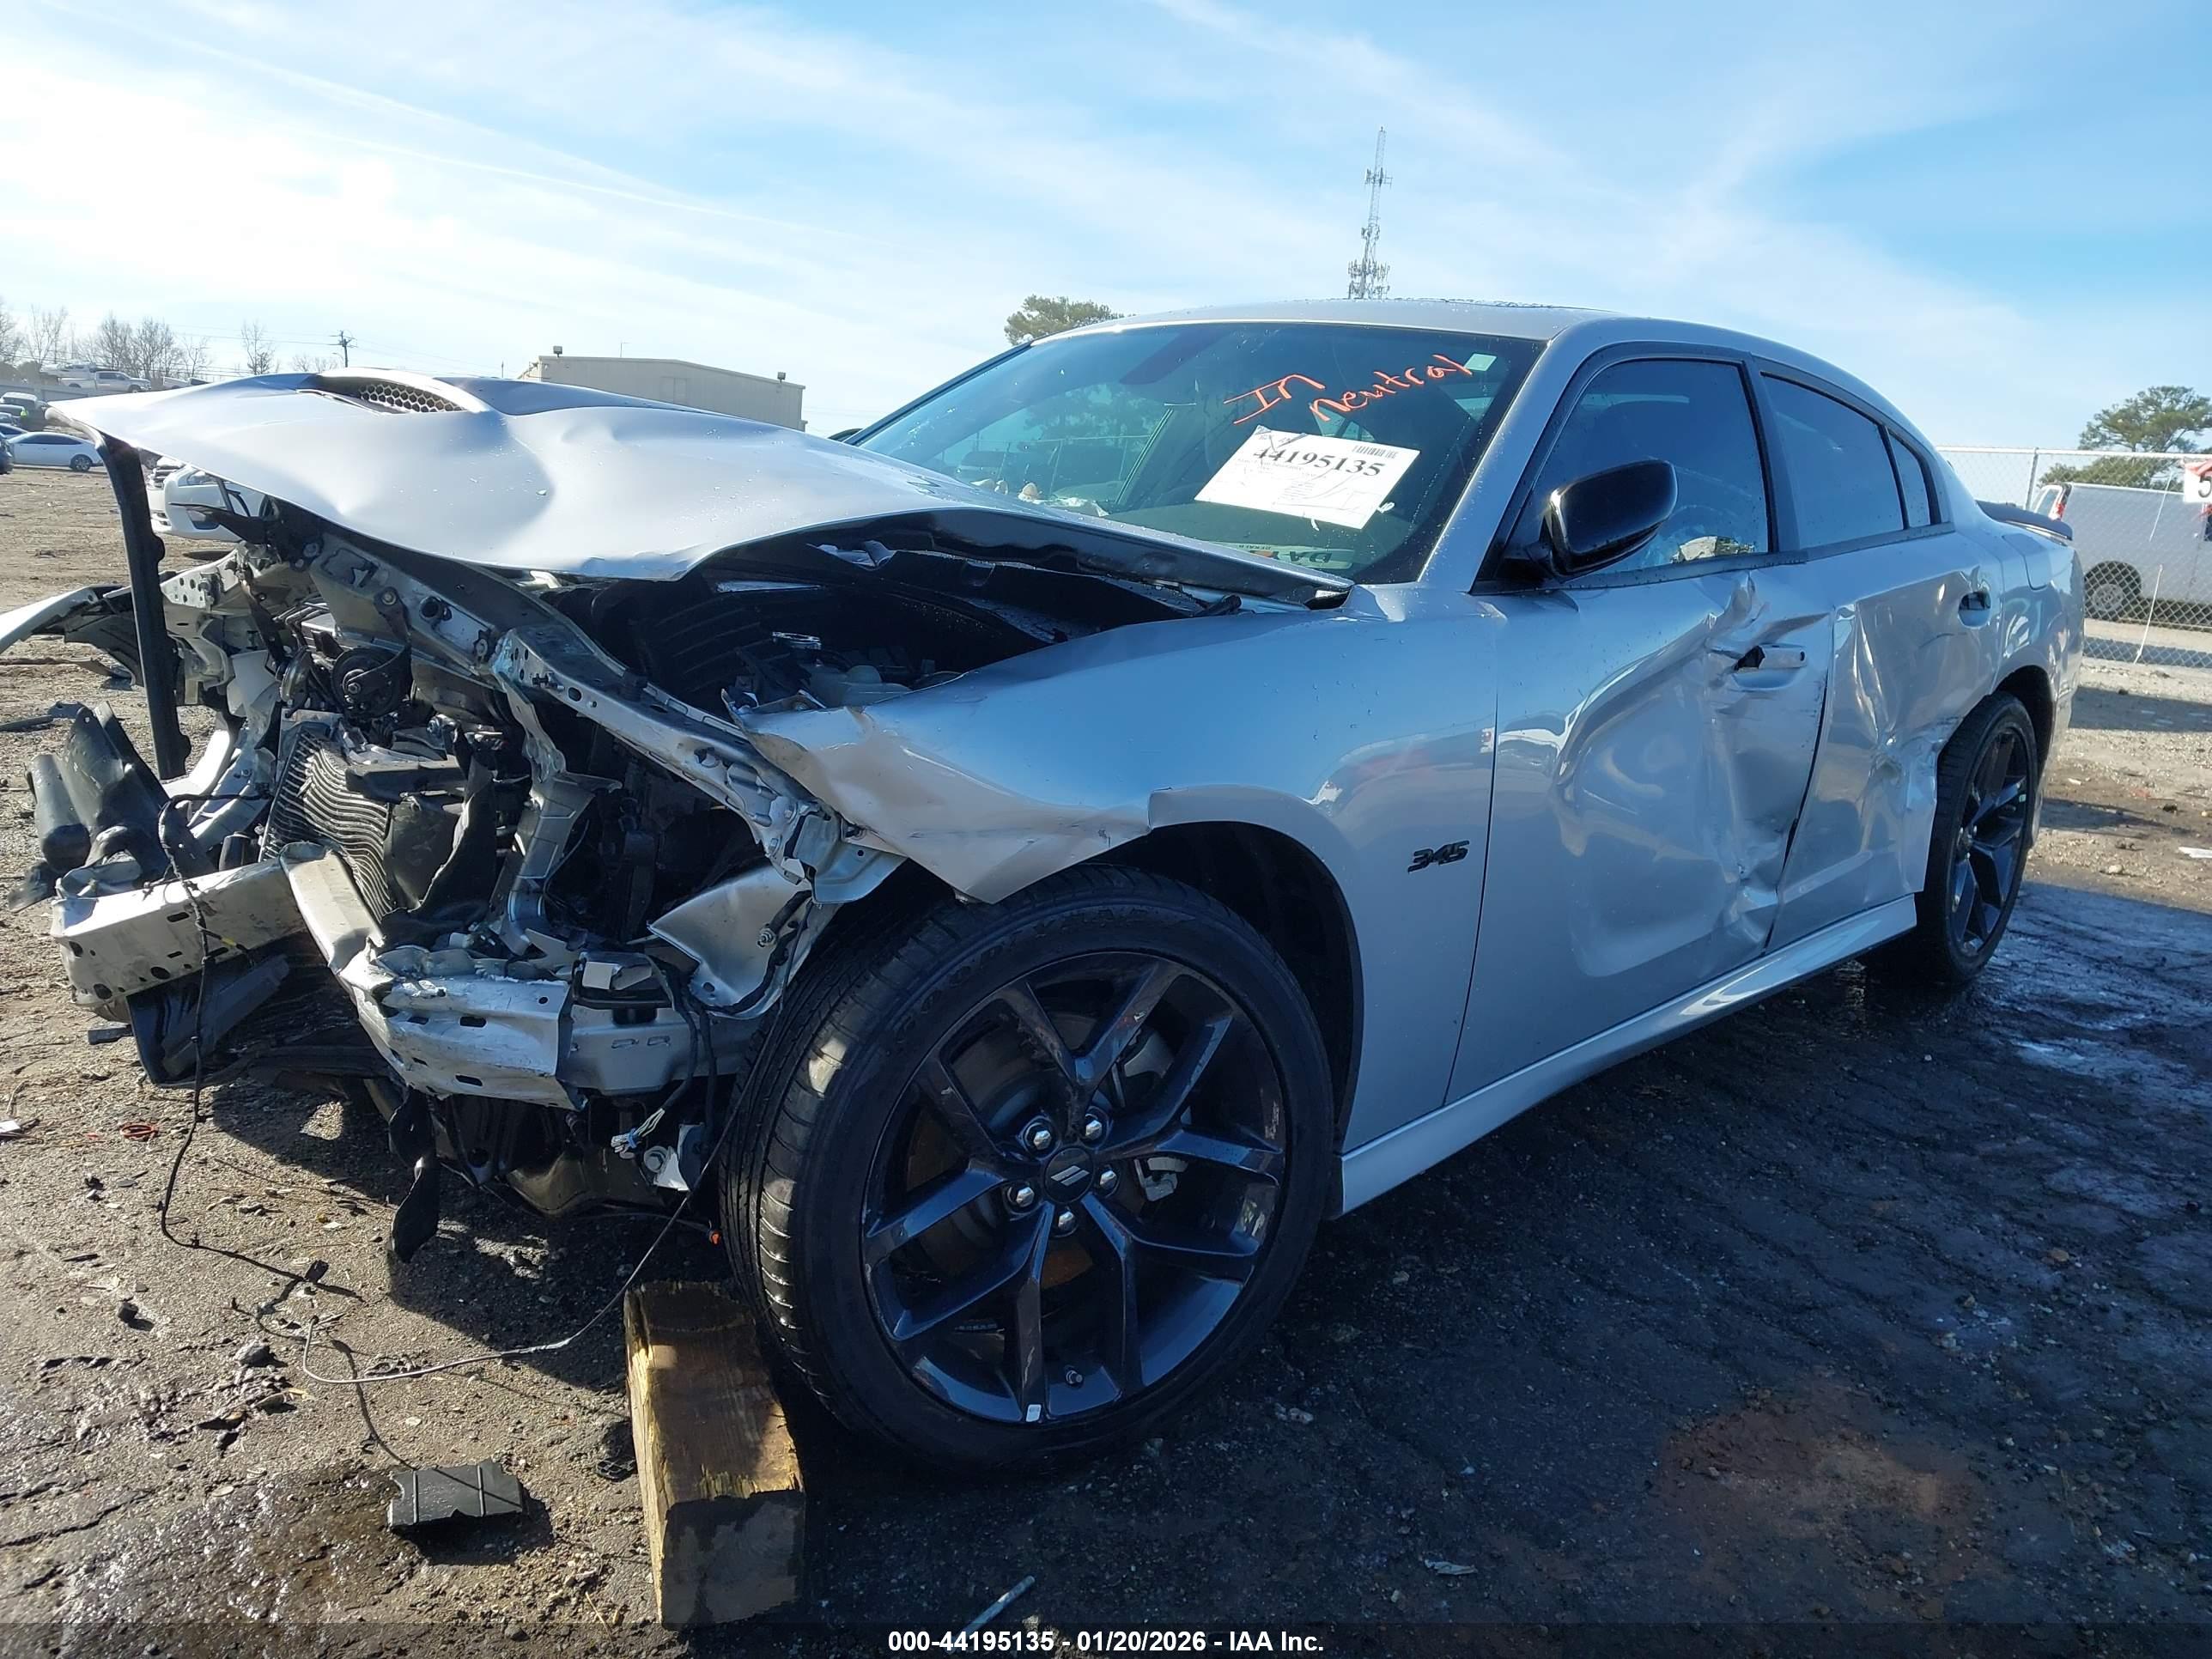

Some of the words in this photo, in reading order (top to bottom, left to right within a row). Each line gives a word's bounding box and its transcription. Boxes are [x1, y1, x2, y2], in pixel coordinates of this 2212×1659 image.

[1223, 373, 1326, 425] In
[1252, 444, 1385, 477] 44195135
[1407, 840, 1470, 873] 345
